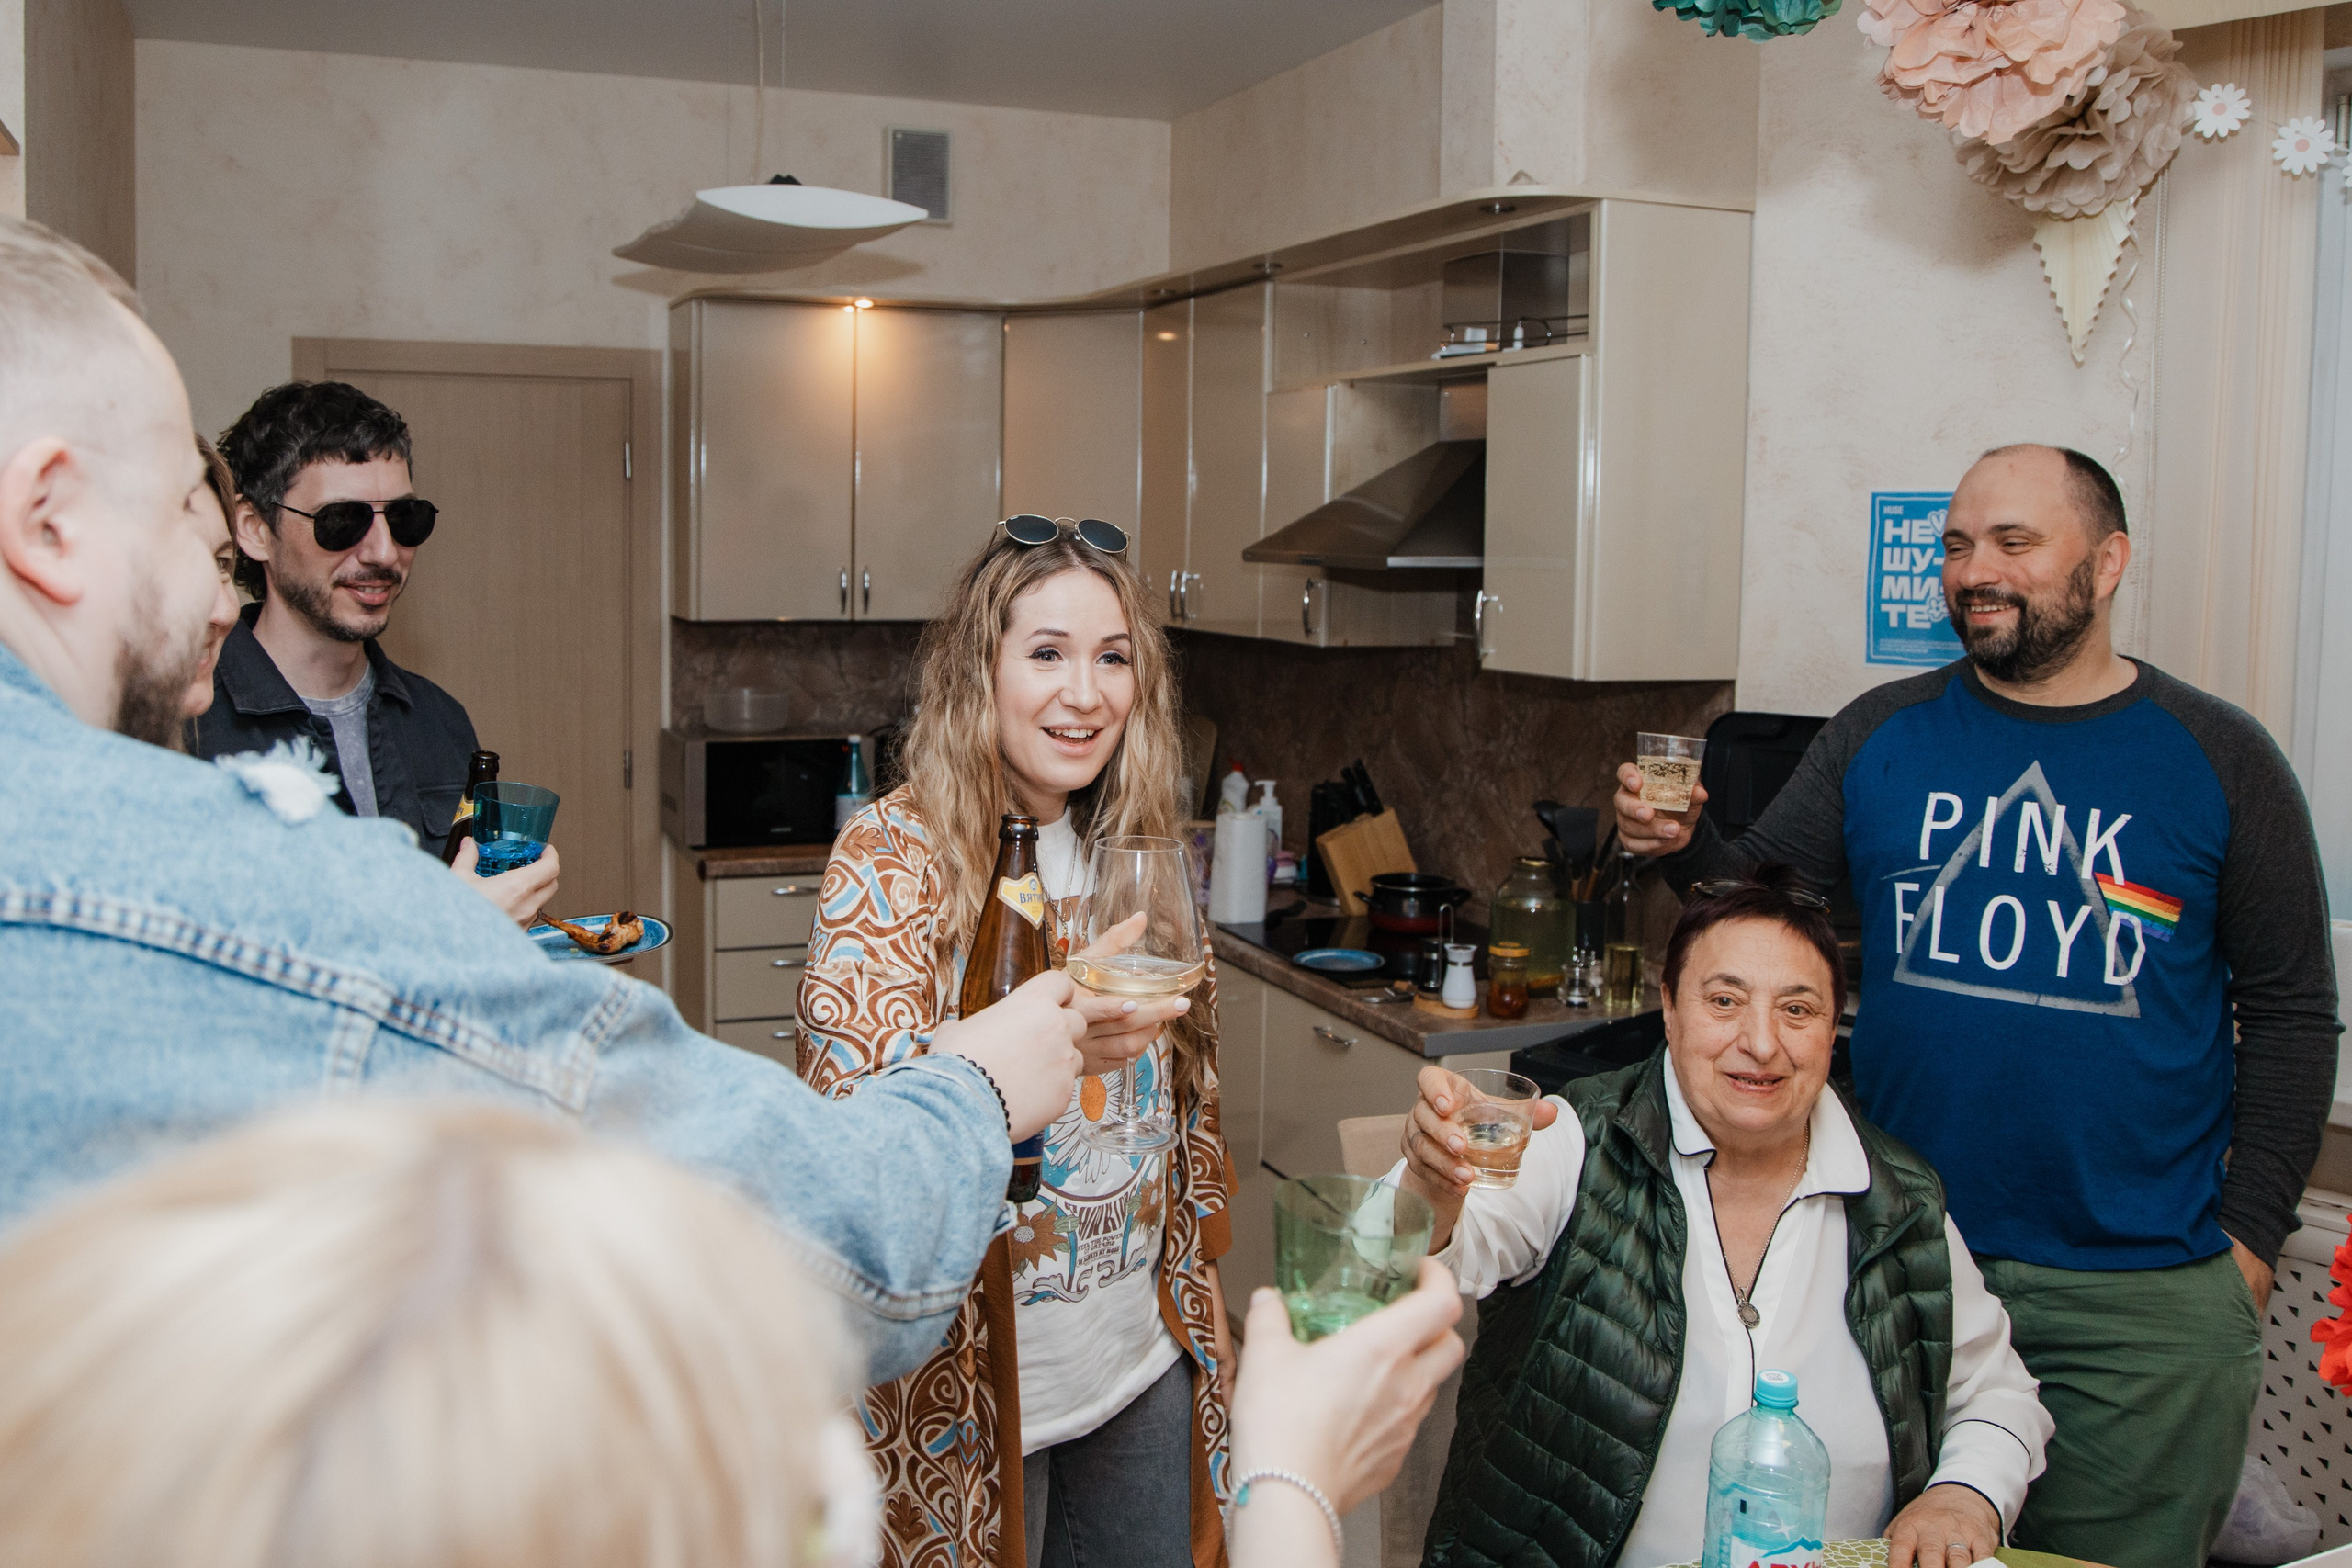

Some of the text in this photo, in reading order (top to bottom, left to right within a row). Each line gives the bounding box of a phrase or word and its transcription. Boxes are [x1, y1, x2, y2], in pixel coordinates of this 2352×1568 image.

[1883, 519, 1936, 544] НЕ
[1880, 575, 1943, 600] МИ
[1880, 604, 1931, 629] ТЕ
[1919, 792, 2132, 885] PINK
[1894, 882, 2146, 986] FLOYD
